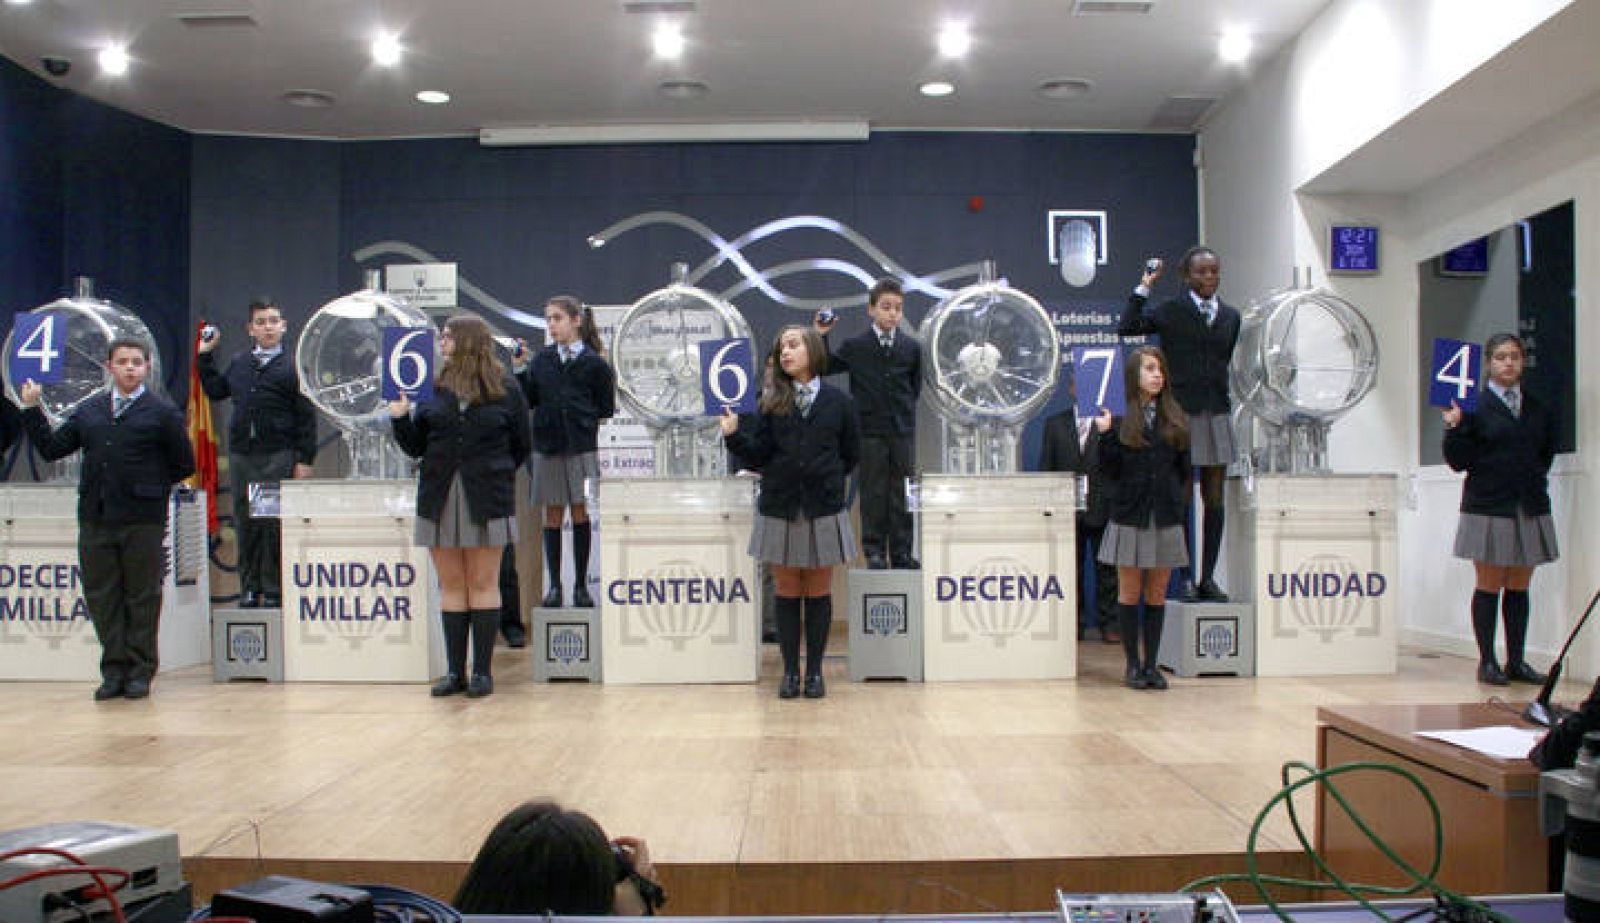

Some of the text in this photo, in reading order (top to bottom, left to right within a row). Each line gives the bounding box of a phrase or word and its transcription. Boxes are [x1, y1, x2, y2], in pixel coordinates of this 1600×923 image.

[17, 314, 59, 373] 4
[389, 330, 429, 391] 6
[709, 340, 748, 403] 6
[1436, 344, 1475, 400] 4
[1081, 349, 1116, 406] 7
[0, 563, 80, 589] DECEN
[293, 562, 416, 589] UNIDAD
[937, 574, 1064, 603] DECENA
[1268, 572, 1387, 600] UNIDAD
[608, 577, 750, 606] CENTENA
[0, 596, 92, 622] MILLA
[299, 595, 412, 622] MILLAR
